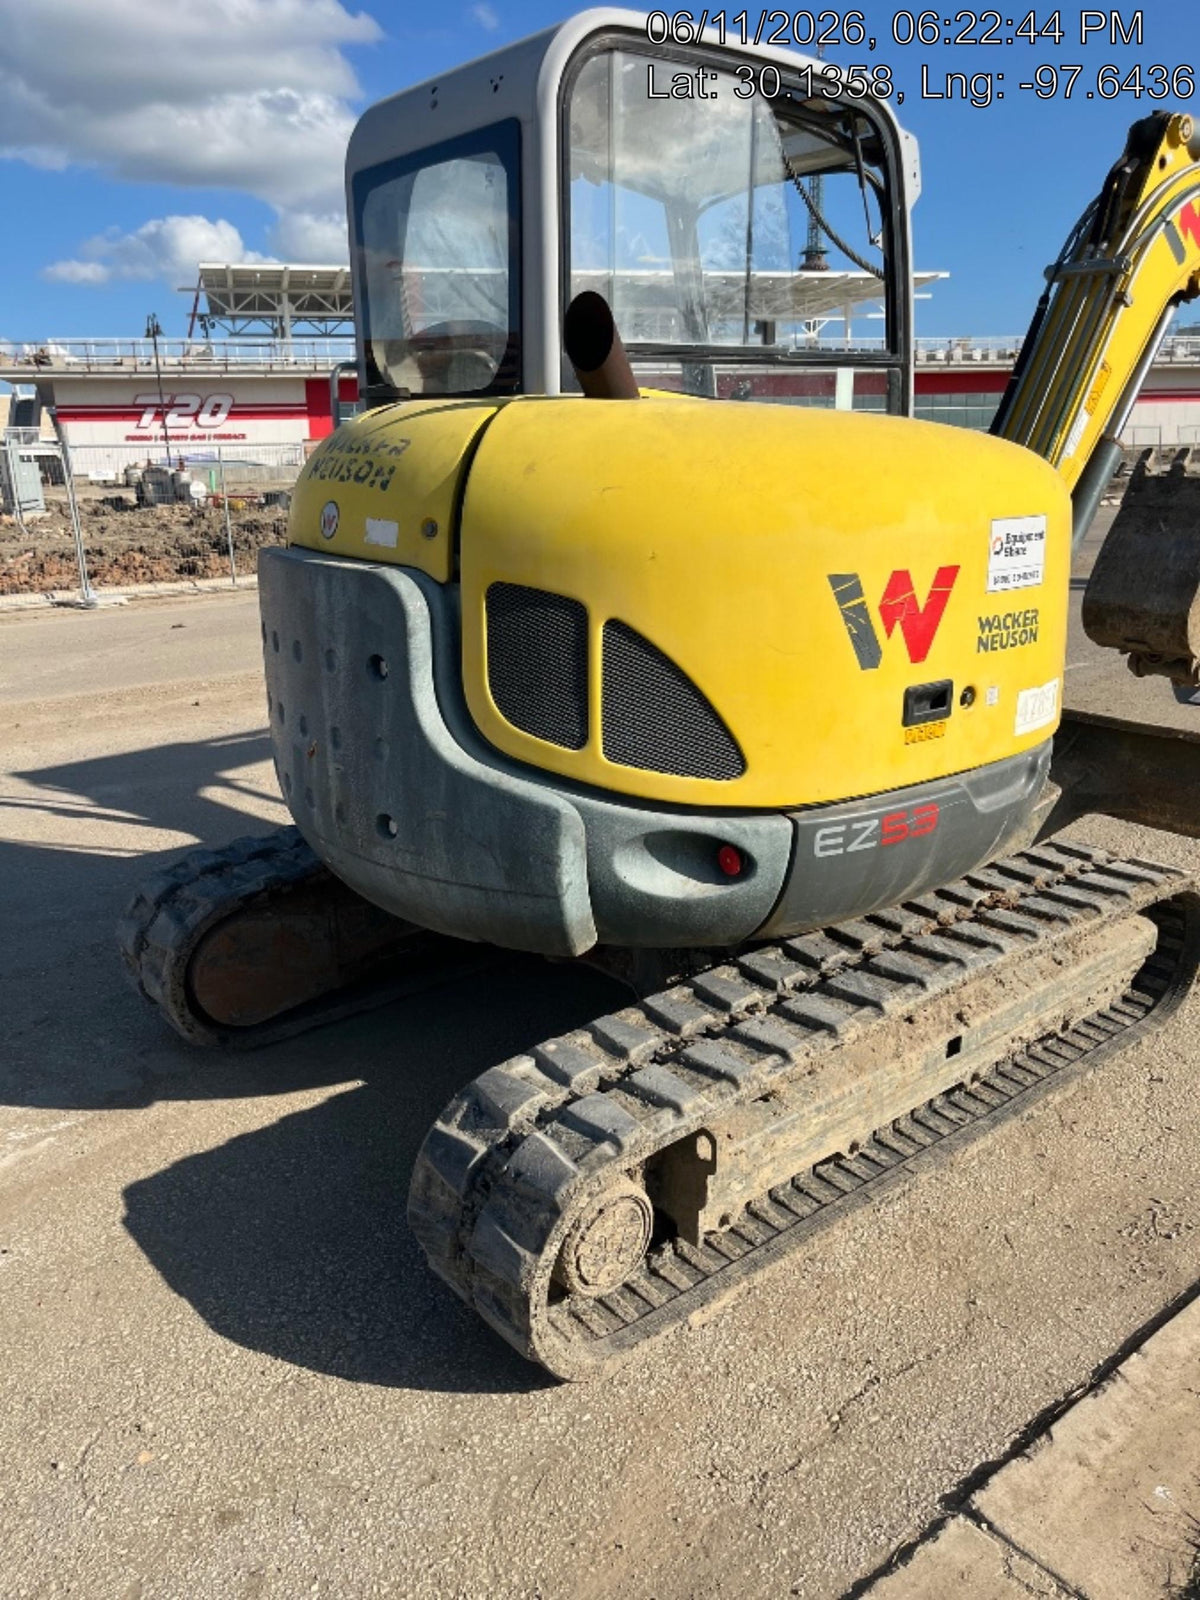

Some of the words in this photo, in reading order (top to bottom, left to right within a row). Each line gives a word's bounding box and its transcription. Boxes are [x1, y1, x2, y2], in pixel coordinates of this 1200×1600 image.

[132, 392, 236, 429] T20
[977, 608, 1040, 634] WACKER
[976, 626, 1039, 654] NEUSON
[813, 802, 941, 858] EZ53
